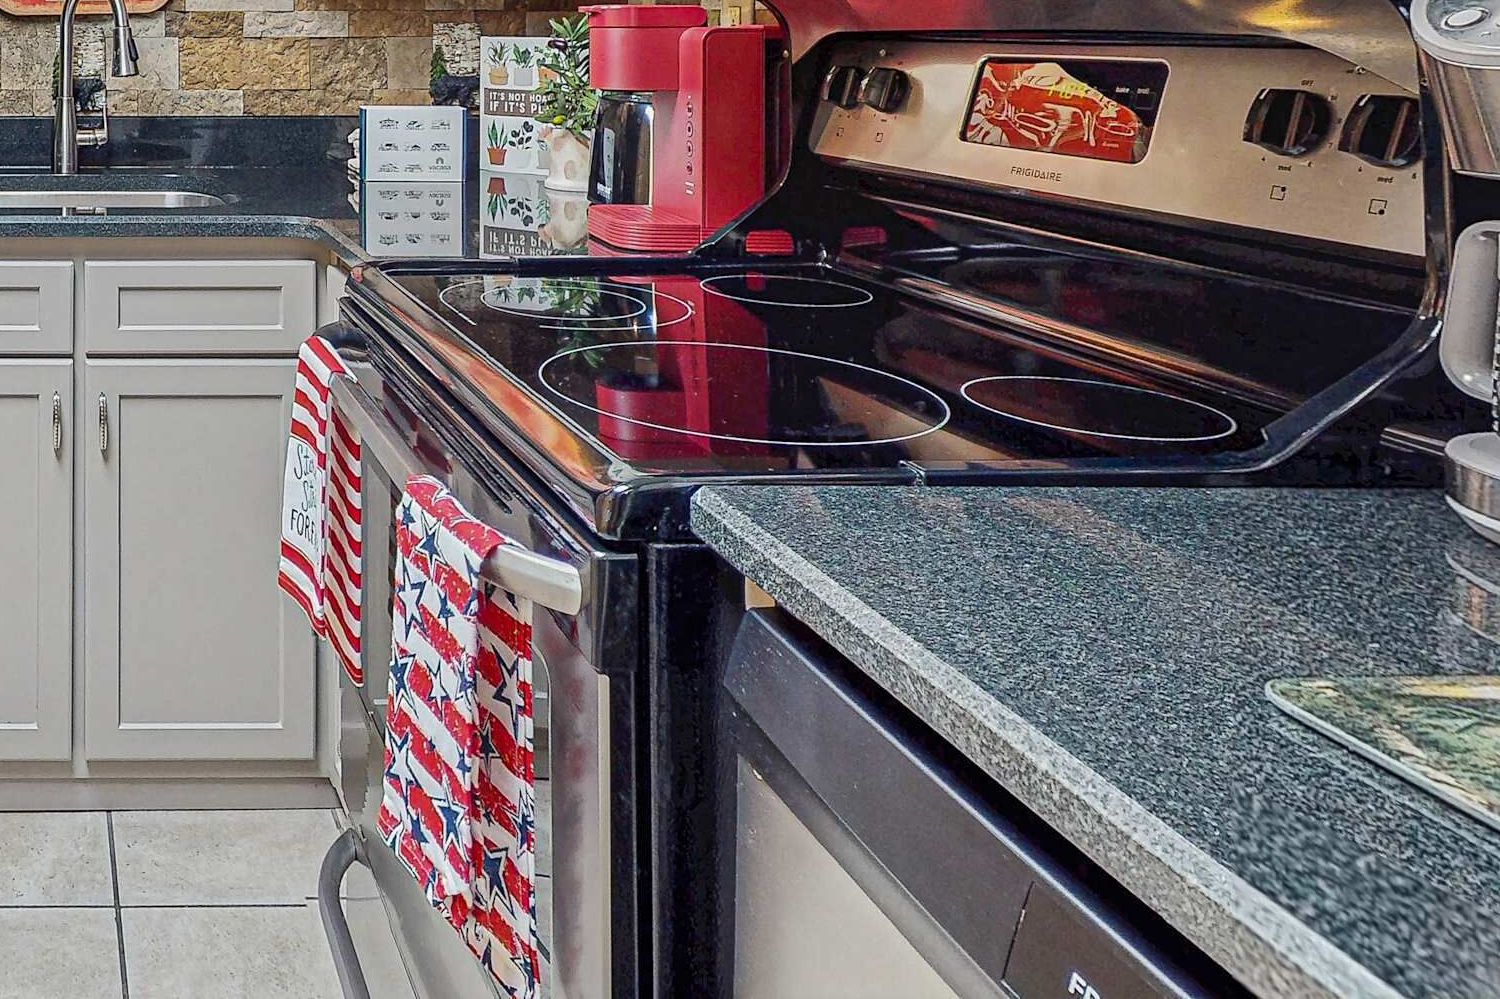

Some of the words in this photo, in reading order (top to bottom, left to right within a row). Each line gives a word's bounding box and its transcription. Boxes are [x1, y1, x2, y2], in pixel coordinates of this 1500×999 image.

[489, 92, 506, 101] IT'S
[508, 93, 526, 102] NOT
[489, 101, 499, 112] IF
[504, 102, 526, 113] IT'S
[1010, 166, 1063, 182] FRIGIDAIRE
